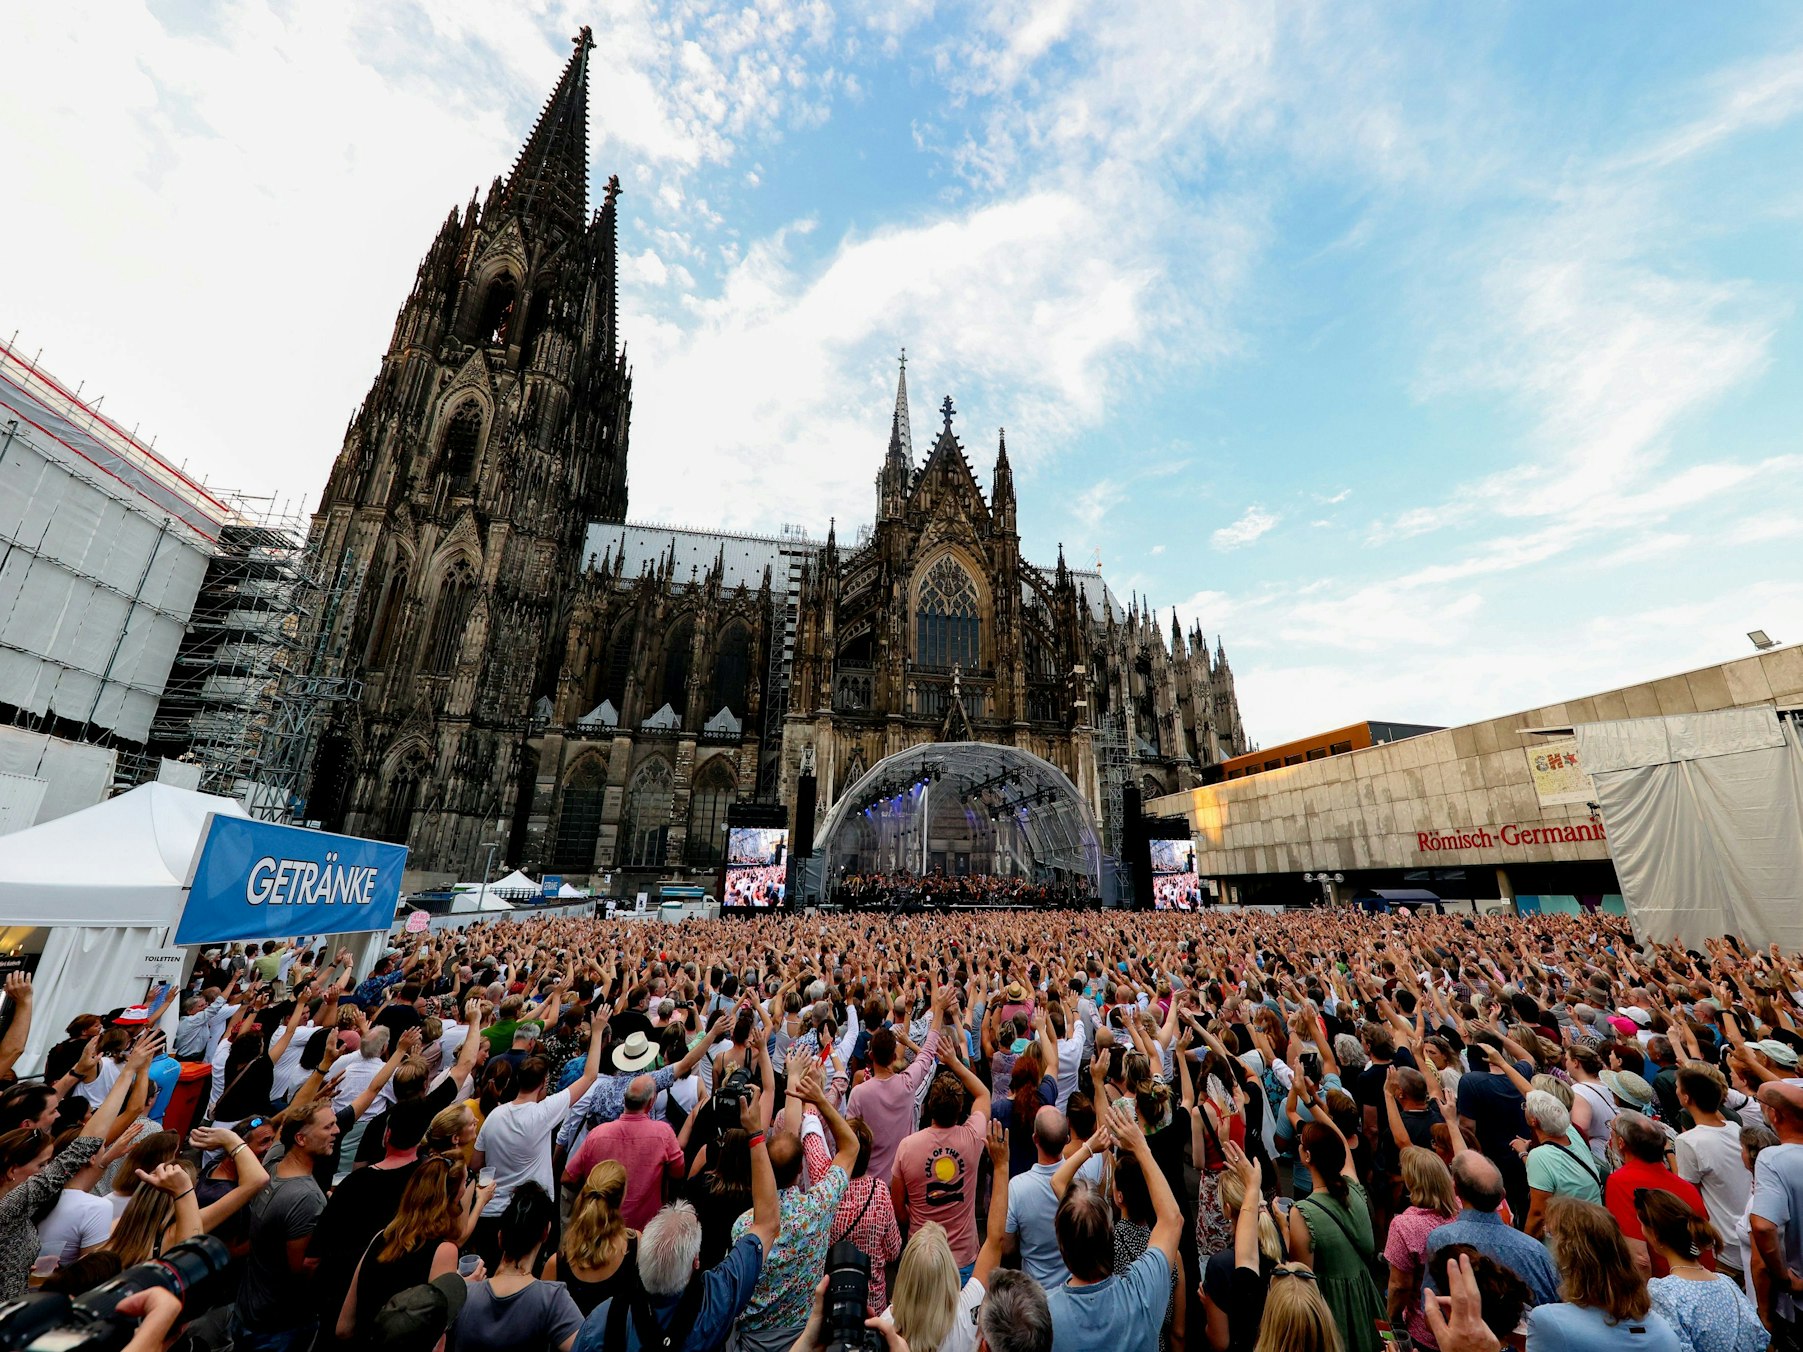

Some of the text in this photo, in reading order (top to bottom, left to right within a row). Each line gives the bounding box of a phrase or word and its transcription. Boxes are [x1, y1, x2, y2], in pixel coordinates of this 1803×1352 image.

[246, 851, 378, 905] GETRÄNKE
[925, 1157, 934, 1179] CALL
[933, 1147, 943, 1158] OF
[945, 1147, 960, 1160] THE
